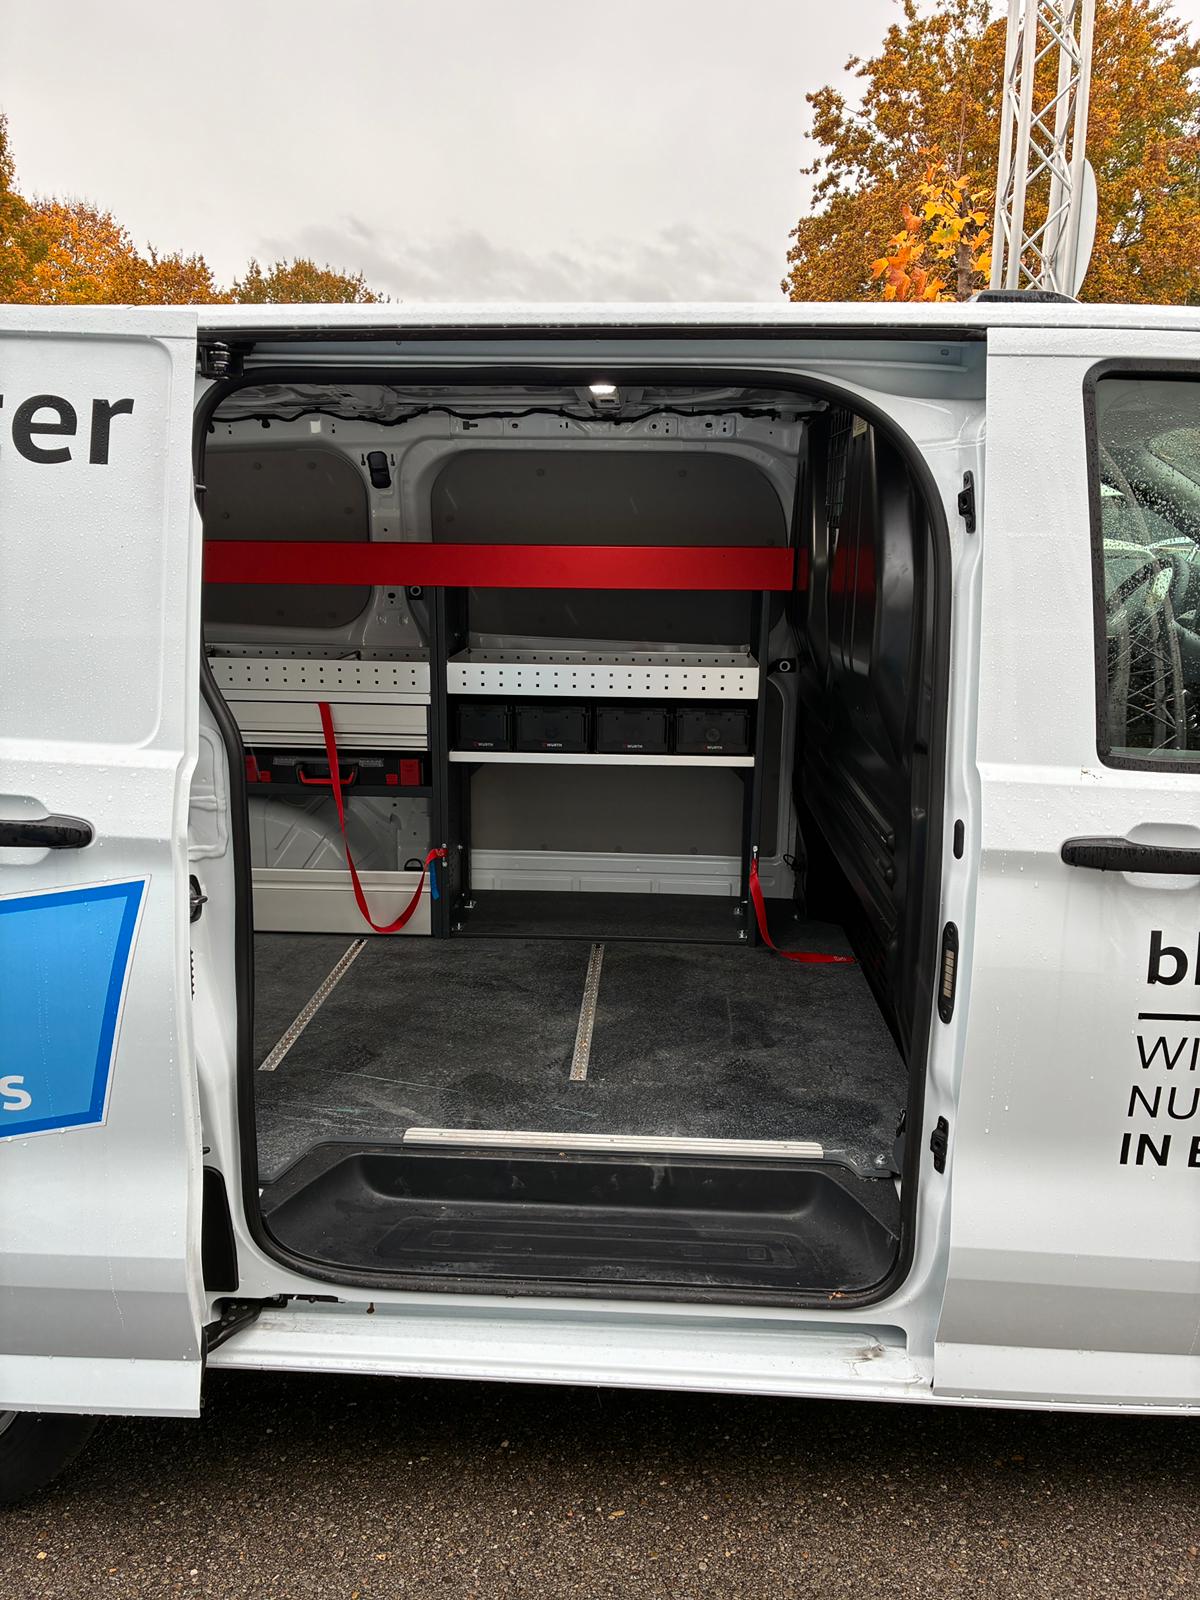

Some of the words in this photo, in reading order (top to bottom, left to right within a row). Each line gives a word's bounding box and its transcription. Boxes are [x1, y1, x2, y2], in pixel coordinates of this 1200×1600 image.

[0, 394, 135, 465] er
[1136, 1035, 1200, 1071] WI
[1127, 1085, 1200, 1120] NU
[1119, 1133, 1172, 1167] IN
